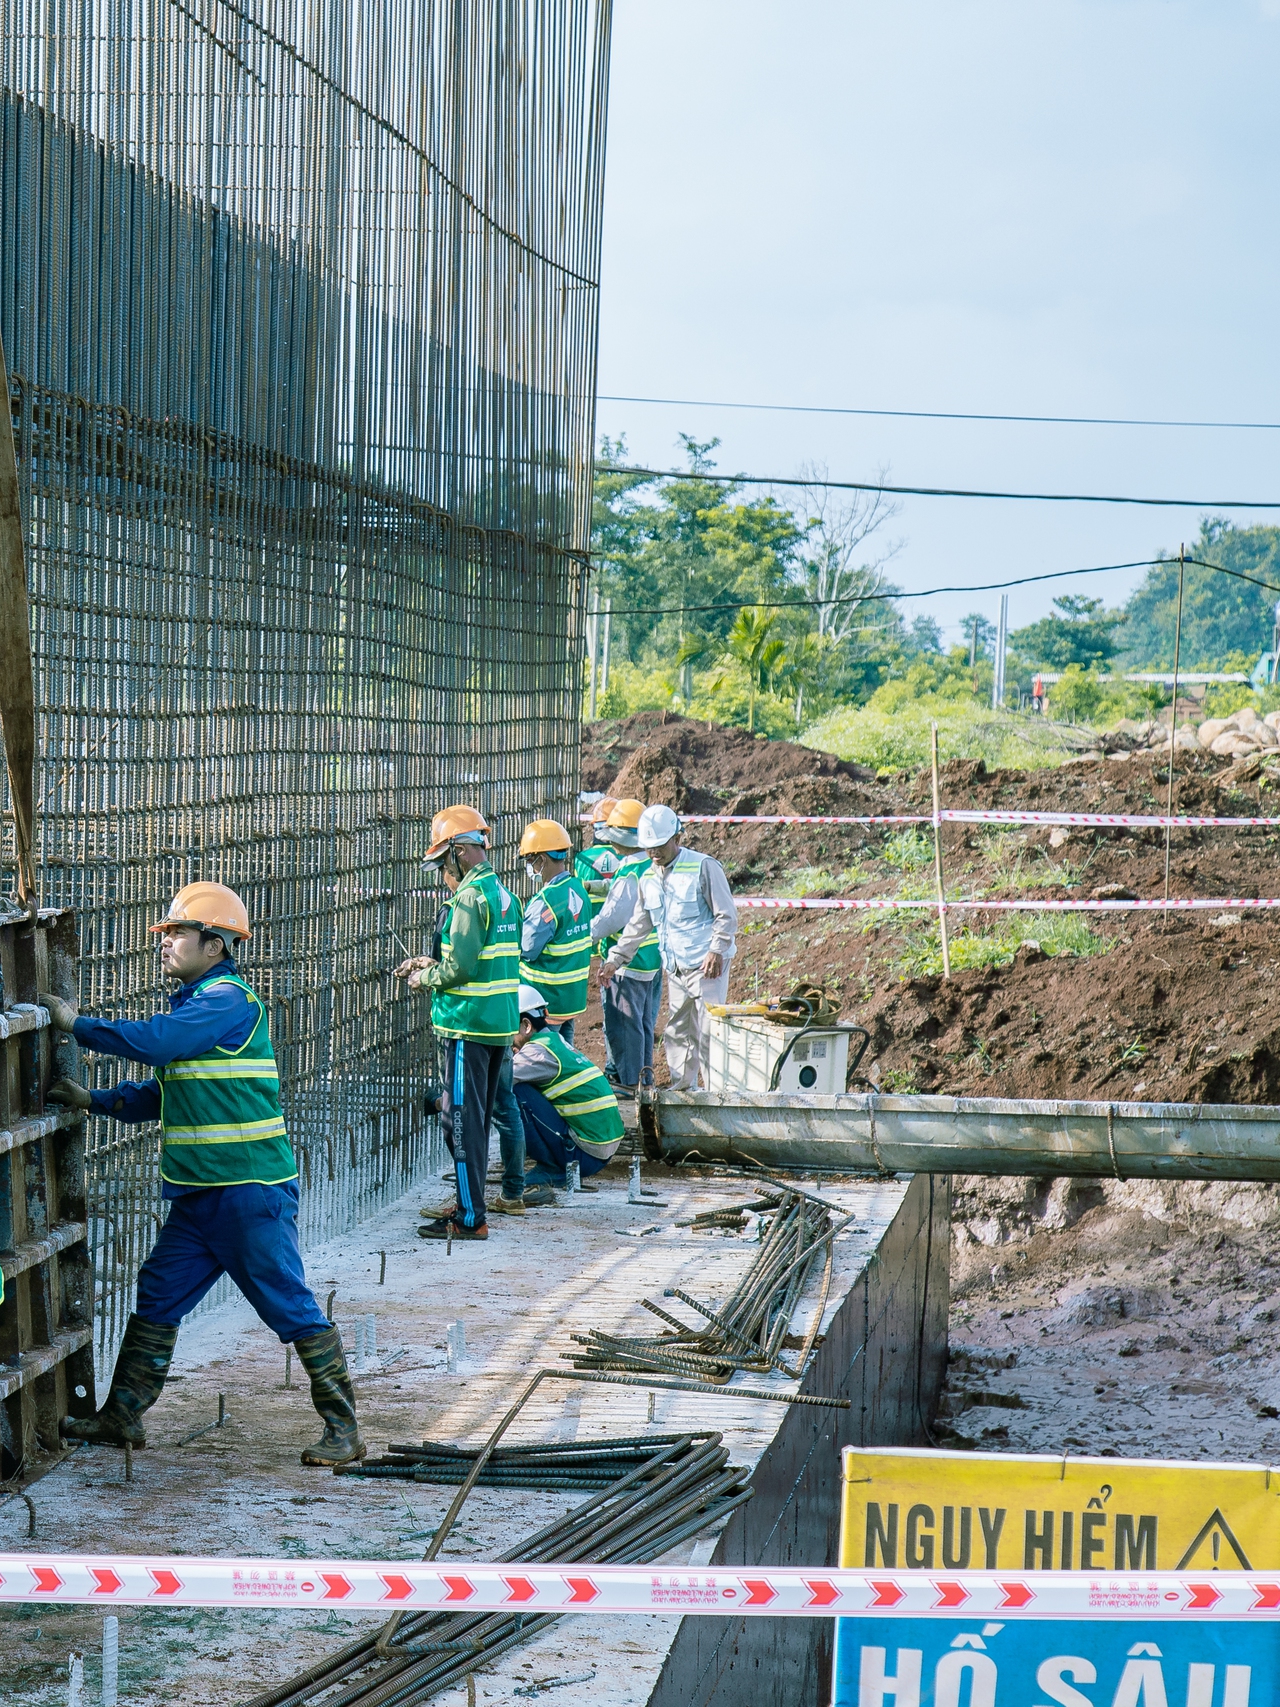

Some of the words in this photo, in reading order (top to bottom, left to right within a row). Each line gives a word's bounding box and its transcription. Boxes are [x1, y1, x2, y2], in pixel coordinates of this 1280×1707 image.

[454, 1111, 463, 1146] adidas
[864, 1502, 1007, 1570] NGUY
[1024, 1484, 1158, 1571] HIỂM
[860, 1622, 1006, 1707] HỐ
